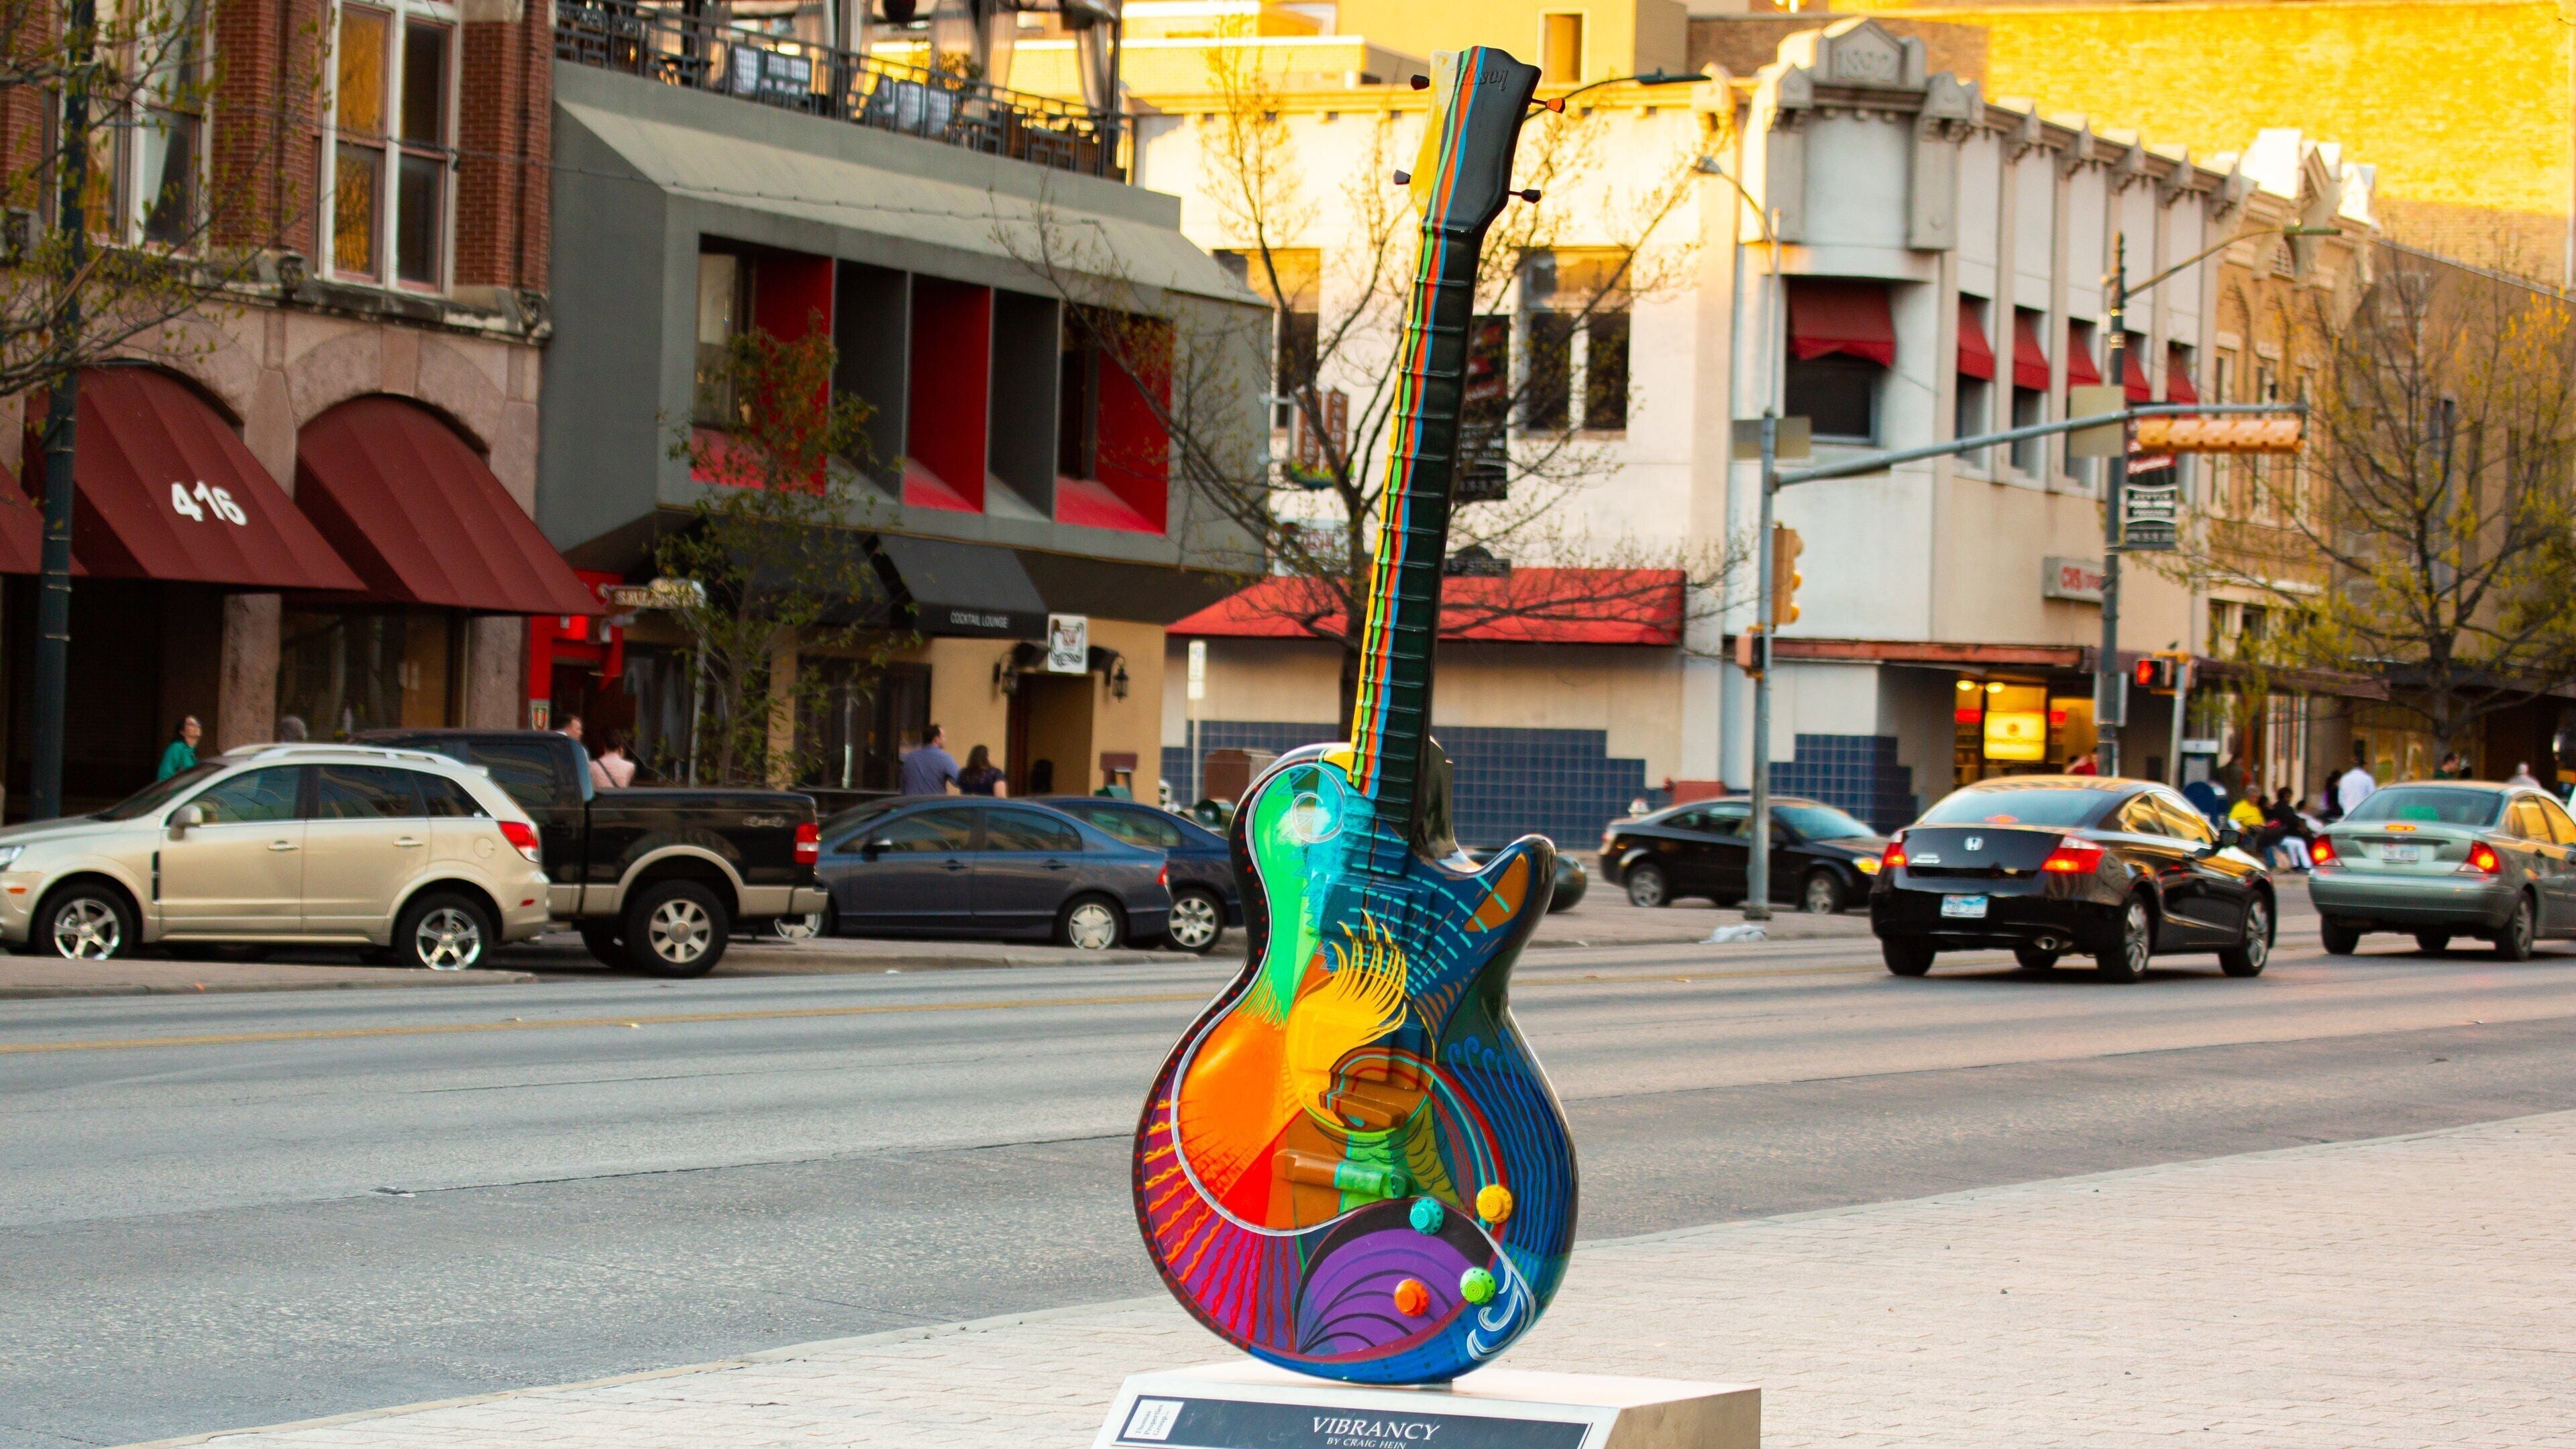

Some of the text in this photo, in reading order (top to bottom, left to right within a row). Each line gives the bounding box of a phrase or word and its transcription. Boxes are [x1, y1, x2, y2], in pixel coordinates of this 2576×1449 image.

[1449, 59, 1509, 91] Gibson
[171, 480, 247, 526] 416
[2061, 566, 2082, 590] CVS
[950, 611, 1009, 629] COCKTAIL LOUNGE
[1135, 1411, 1152, 1434] Thomas
[1144, 1405, 1164, 1435] Properties
[1313, 1416, 1441, 1440] VIBRANCY
[1326, 1437, 1407, 1449] BY CRAIG HEIN
